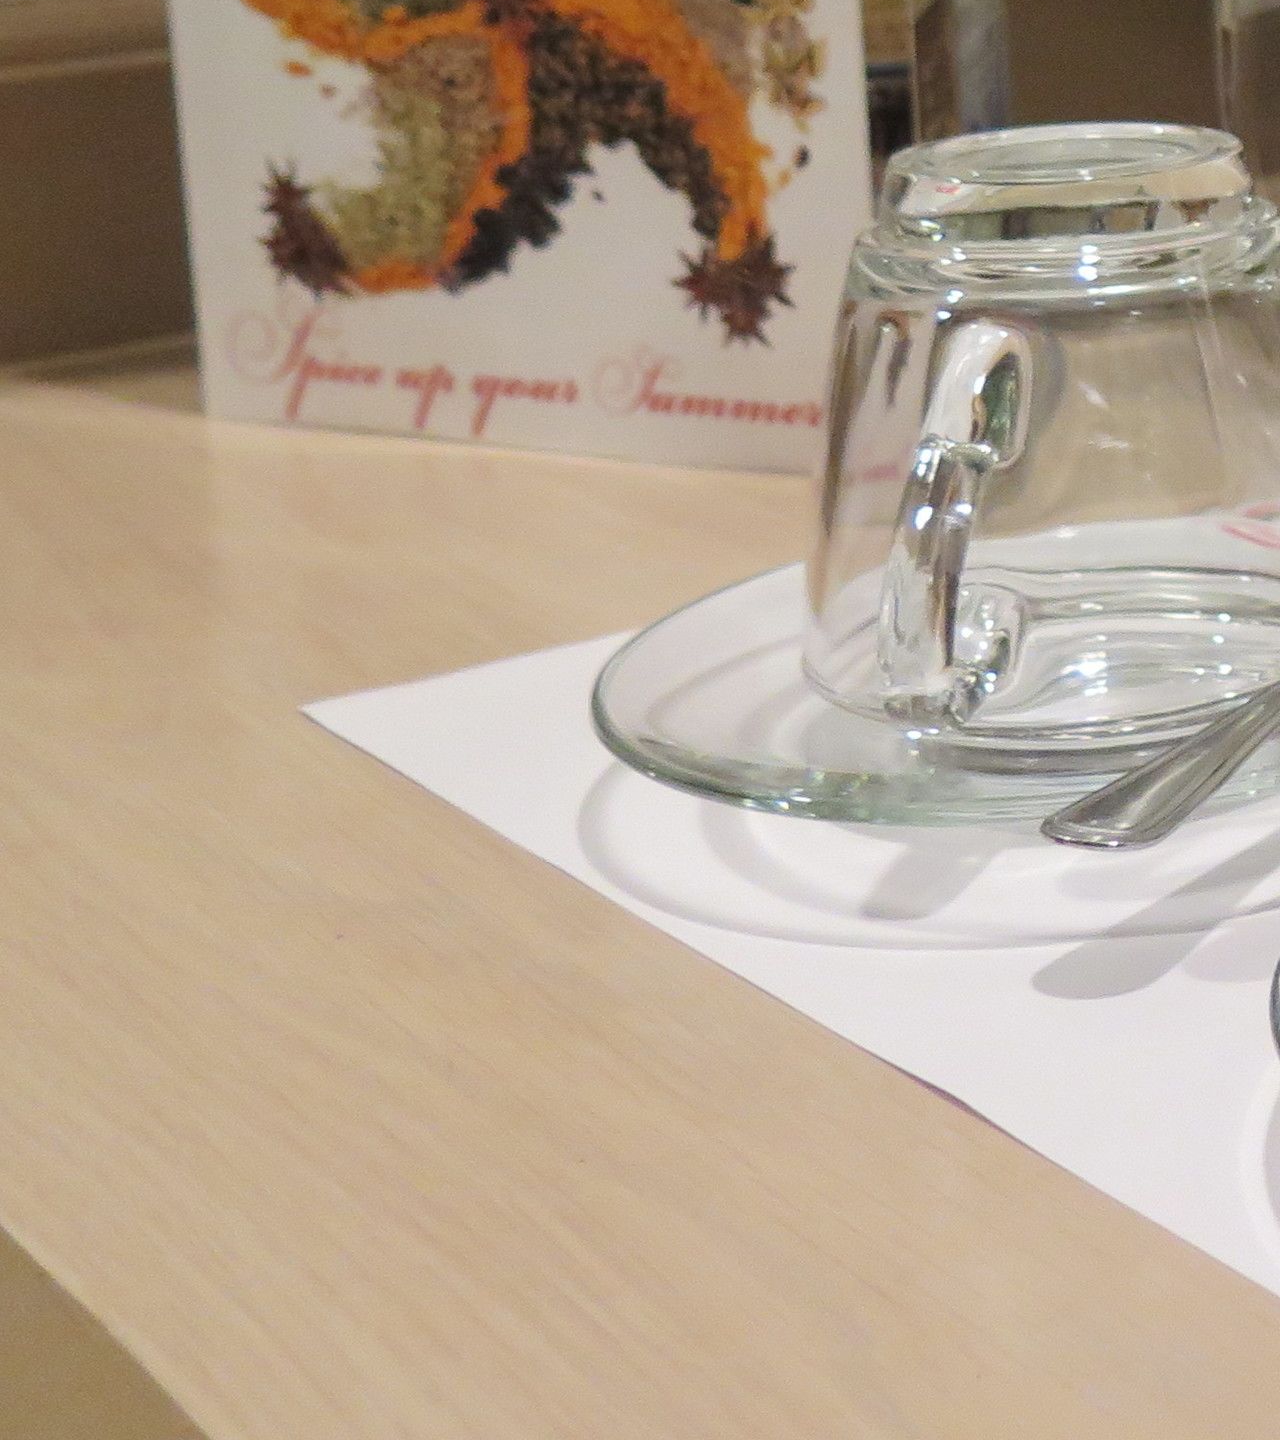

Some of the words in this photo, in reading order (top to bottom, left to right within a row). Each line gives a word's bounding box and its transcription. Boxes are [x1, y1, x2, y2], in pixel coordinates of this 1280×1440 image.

[395, 364, 456, 430] up
[471, 374, 579, 437] your
[596, 347, 822, 427] Summer
